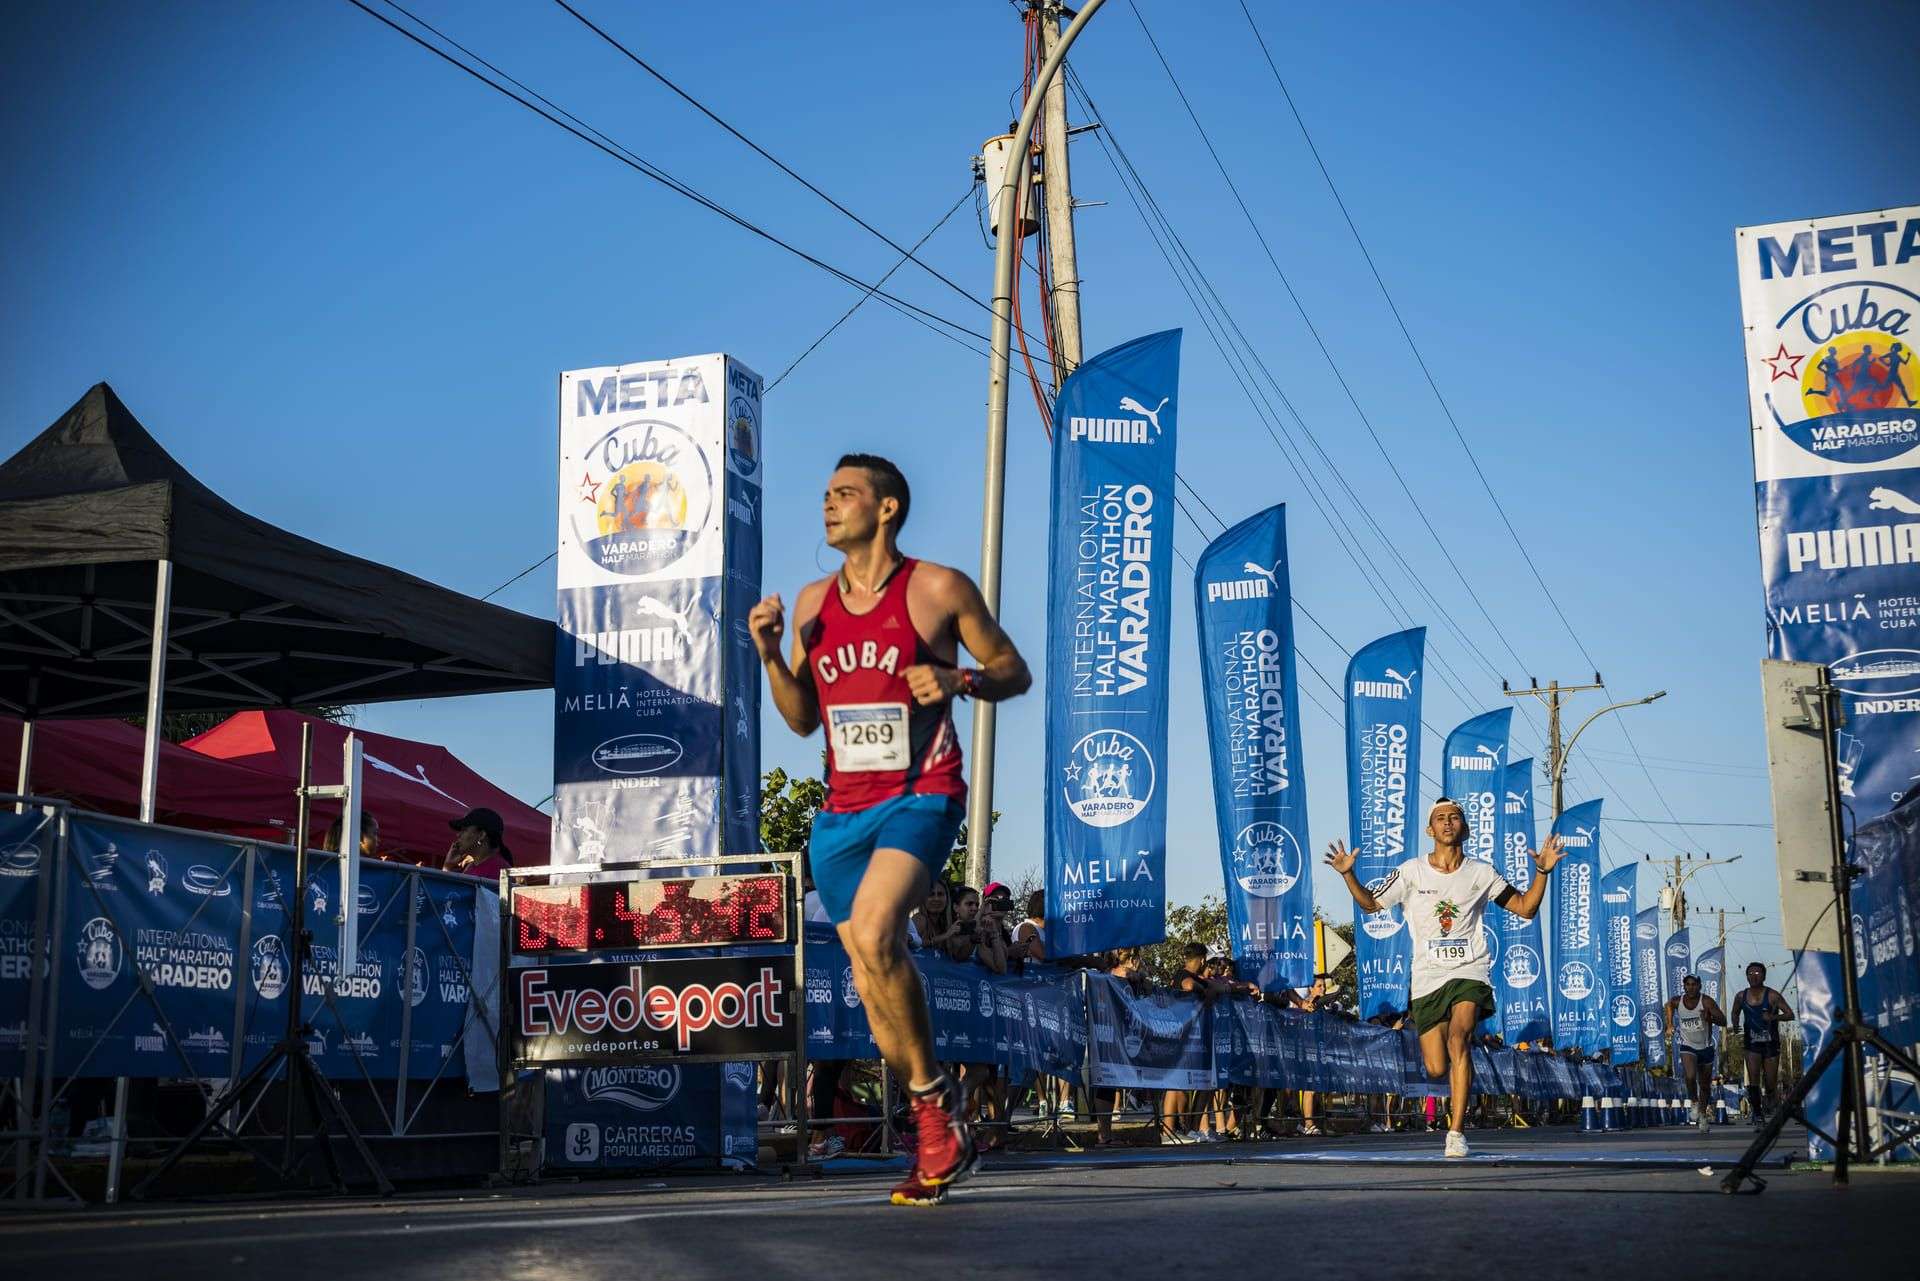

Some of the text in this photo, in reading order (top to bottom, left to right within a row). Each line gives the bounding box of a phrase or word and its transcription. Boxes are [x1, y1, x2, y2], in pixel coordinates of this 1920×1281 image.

[1757, 218, 1920, 280] META
[1801, 288, 1912, 345] Cuba
[577, 366, 710, 417] META
[728, 365, 760, 402] META
[1069, 417, 1148, 444] PUMA
[1811, 418, 1917, 442] VARADERO
[1812, 431, 1919, 452] HALF MARATHON
[602, 426, 681, 473] Cuba
[601, 540, 677, 556] VARADERO
[601, 554, 625, 564] HALF
[1787, 522, 1920, 572] PUMA
[1073, 485, 1102, 697] INTERNATIONAL
[1096, 484, 1123, 697] HALF MARATHON
[1117, 484, 1154, 697] VARADERO
[1207, 578, 1270, 602] PUMA
[1880, 618, 1917, 629] CUBA
[575, 627, 674, 667] PUMA
[818, 641, 900, 684] CUBA
[636, 689, 671, 698] HOTELS
[1354, 681, 1404, 699] PUMA
[636, 708, 662, 717] CUBA
[1223, 633, 1249, 798] INTERNATIONAL
[1240, 631, 1266, 796] HALF MARATHON
[1256, 629, 1289, 795] VARADERO
[841, 723, 894, 745] 1269
[1083, 733, 1136, 762] Cuba
[1451, 756, 1493, 770] PUMA
[611, 776, 661, 790] INDER
[1361, 724, 1375, 858] INTERNATIONAL
[1373, 723, 1388, 857] HALF MARATHON
[1386, 724, 1408, 857] VARADERO
[1080, 802, 1136, 812] VARADERO
[1246, 824, 1286, 847] Cuba
[1063, 888, 1103, 900] HOTELS
[1063, 899, 1155, 912] INTERNATIONAL
[1577, 863, 1591, 950] VARADERO
[1063, 914, 1095, 924] CUBA
[137, 928, 233, 951] INTERNATIONAL
[169, 949, 233, 967] MARATHON
[1434, 947, 1466, 959] 1199
[520, 967, 783, 1050] Evedeport
[935, 997, 971, 1012] VARADERO
[590, 1067, 672, 1091] MONTERO
[604, 1125, 696, 1144] CARRERAS
